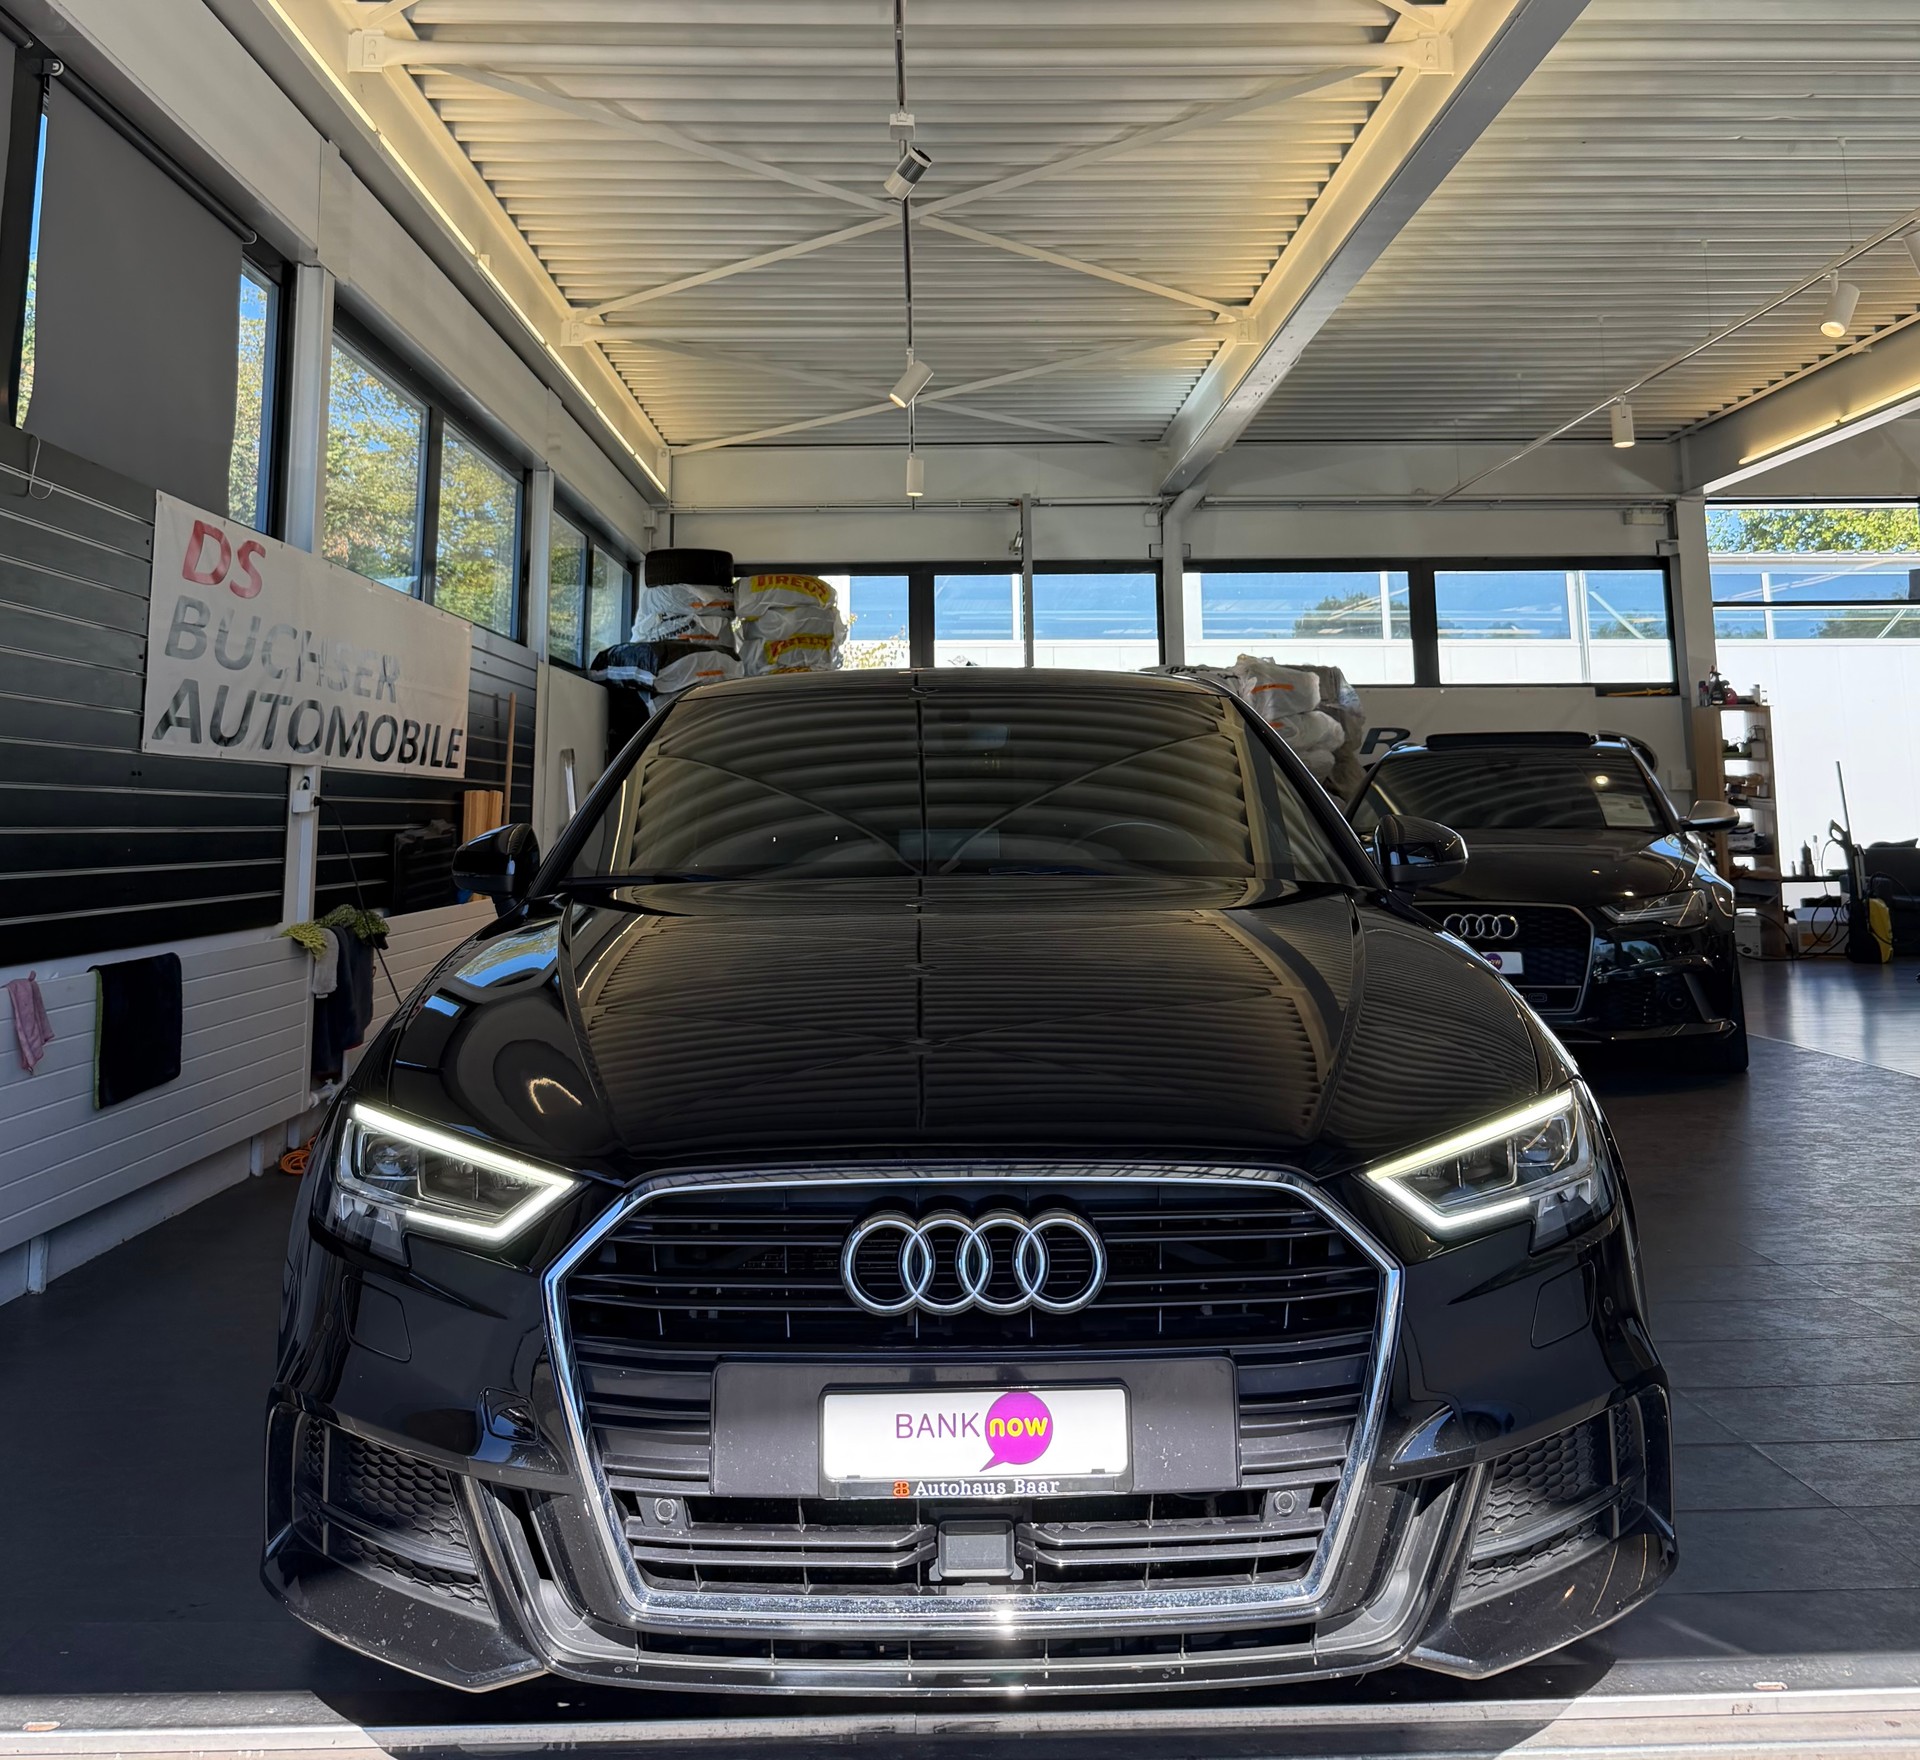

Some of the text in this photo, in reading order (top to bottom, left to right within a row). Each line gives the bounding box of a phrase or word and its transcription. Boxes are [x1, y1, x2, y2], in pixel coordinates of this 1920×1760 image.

[181, 519, 266, 599] DS
[151, 678, 464, 769] AUTOMOBILE
[895, 1412, 1049, 1439] BANK now
[913, 1479, 1006, 1496] Autohaus
[1013, 1478, 1061, 1495] Baar
